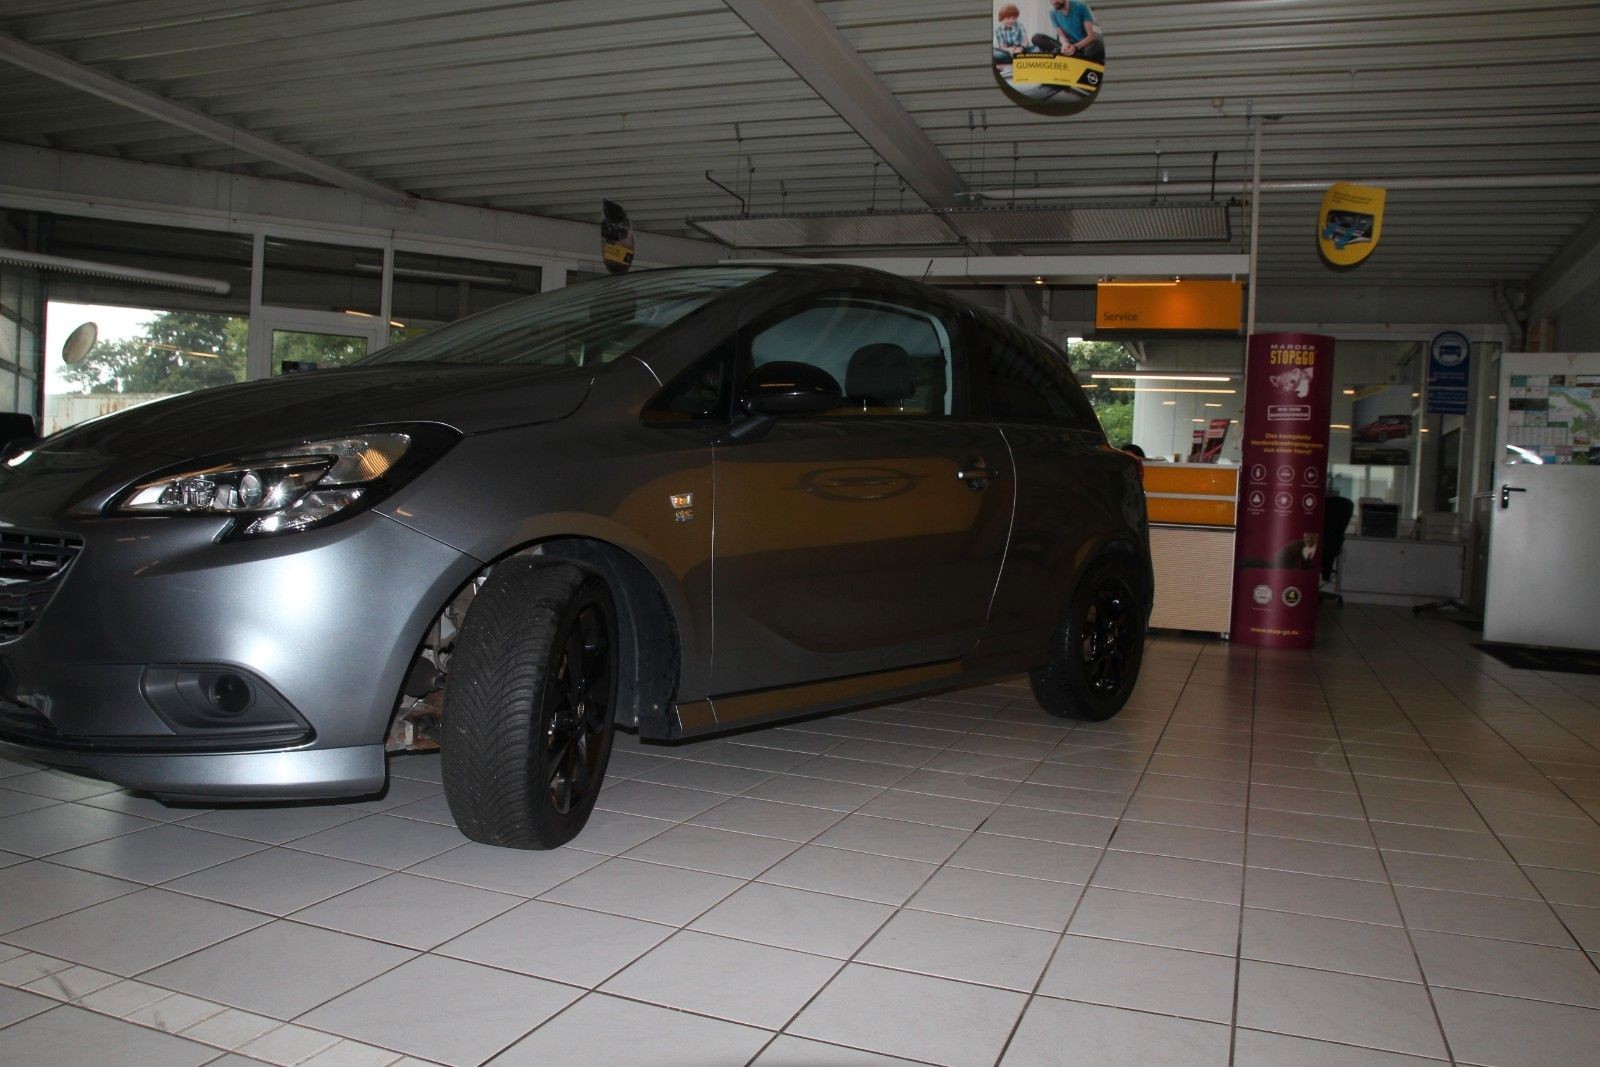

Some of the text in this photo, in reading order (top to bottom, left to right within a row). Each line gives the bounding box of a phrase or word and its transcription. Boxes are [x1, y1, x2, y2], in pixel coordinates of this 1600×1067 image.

[1103, 312, 1138, 321] Service
[1270, 350, 1315, 366] STOP&GO
[1279, 432, 1312, 441] komplette
